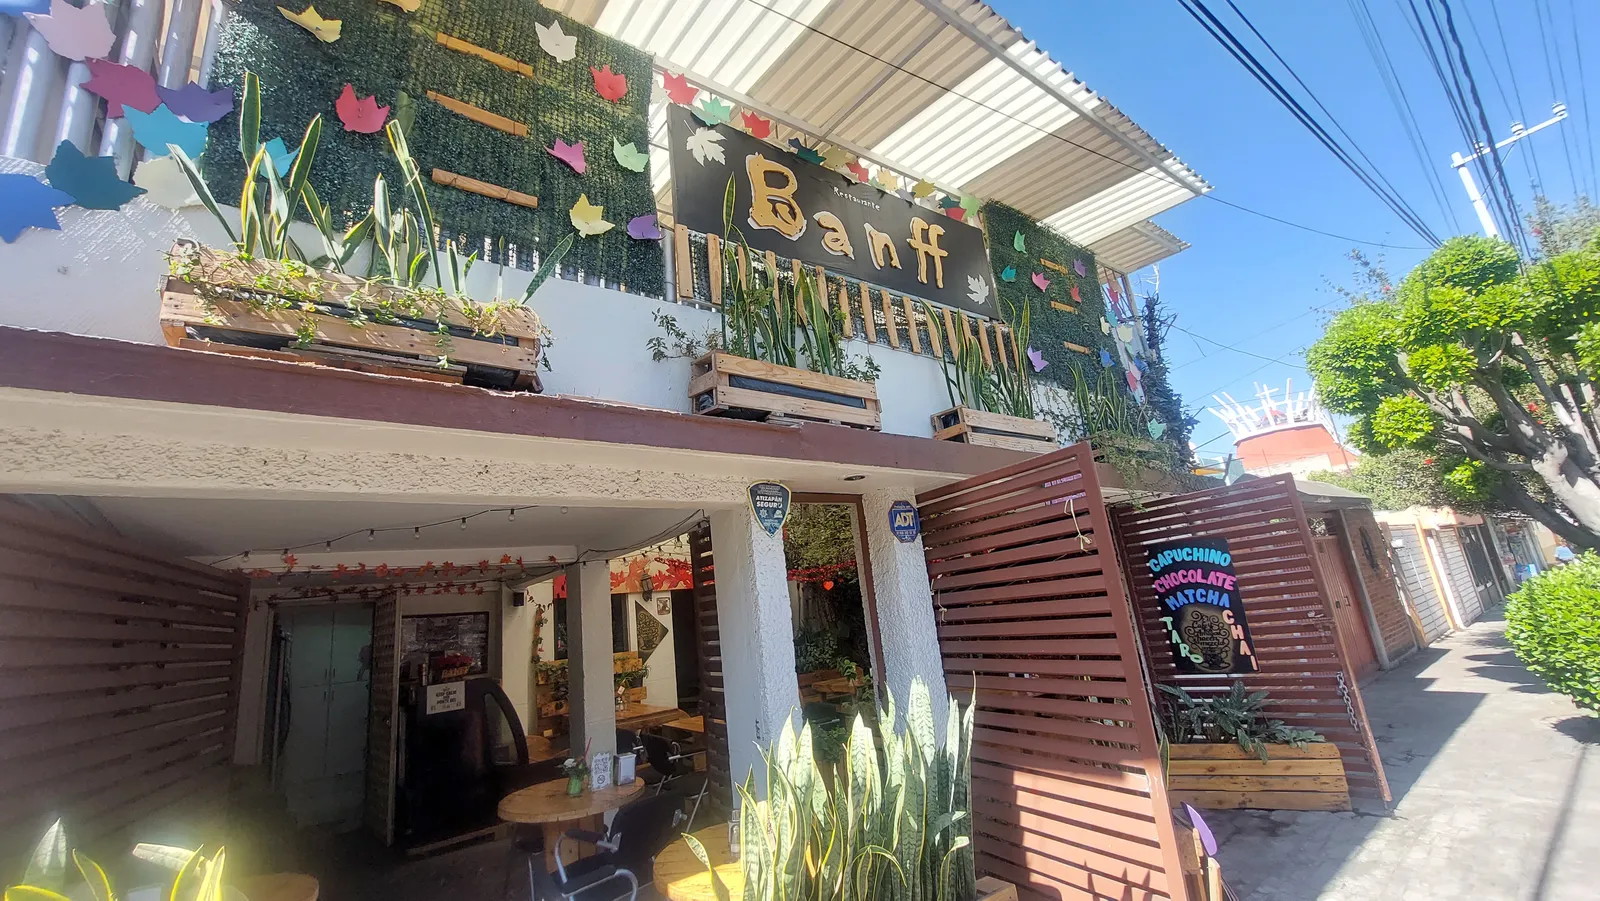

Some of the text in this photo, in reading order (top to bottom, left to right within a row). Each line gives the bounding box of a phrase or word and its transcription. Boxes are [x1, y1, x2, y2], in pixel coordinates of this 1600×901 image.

[833, 186, 881, 211] Restaurante
[745, 151, 949, 289] Banff
[895, 511, 914, 527] ADT
[1149, 547, 1231, 572] CAPUCHINO
[1154, 568, 1237, 593] CHOCOLATE
[1165, 588, 1230, 611] MATCHA
[1160, 616, 1204, 664] TARO
[1222, 609, 1258, 671] CHAI
